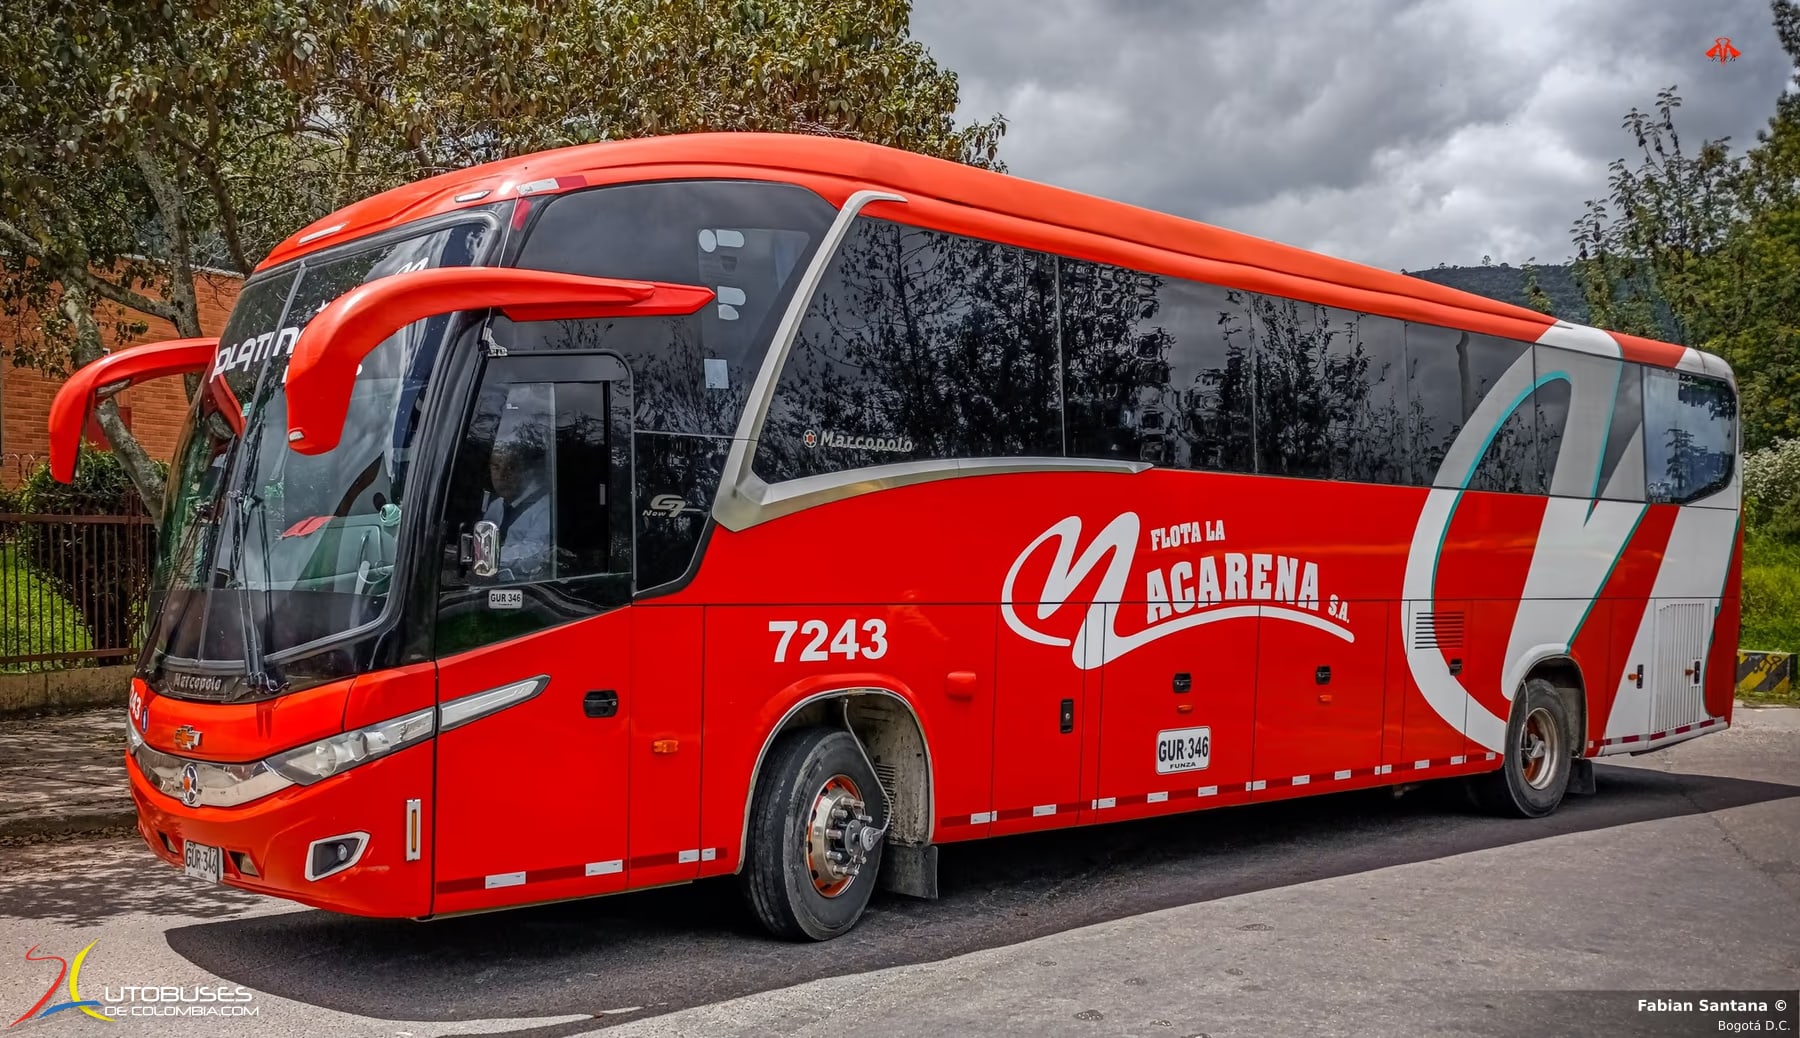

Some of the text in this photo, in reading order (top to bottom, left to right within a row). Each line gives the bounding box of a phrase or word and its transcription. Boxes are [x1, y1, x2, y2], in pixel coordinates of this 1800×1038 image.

[209, 327, 306, 384] PLATIN
[820, 430, 913, 453] Marcopolo
[1151, 520, 1225, 551] FLOTA LA
[490, 593, 521, 602] GUR 346
[1328, 594, 1350, 624] S.A.
[768, 618, 888, 663] 7243
